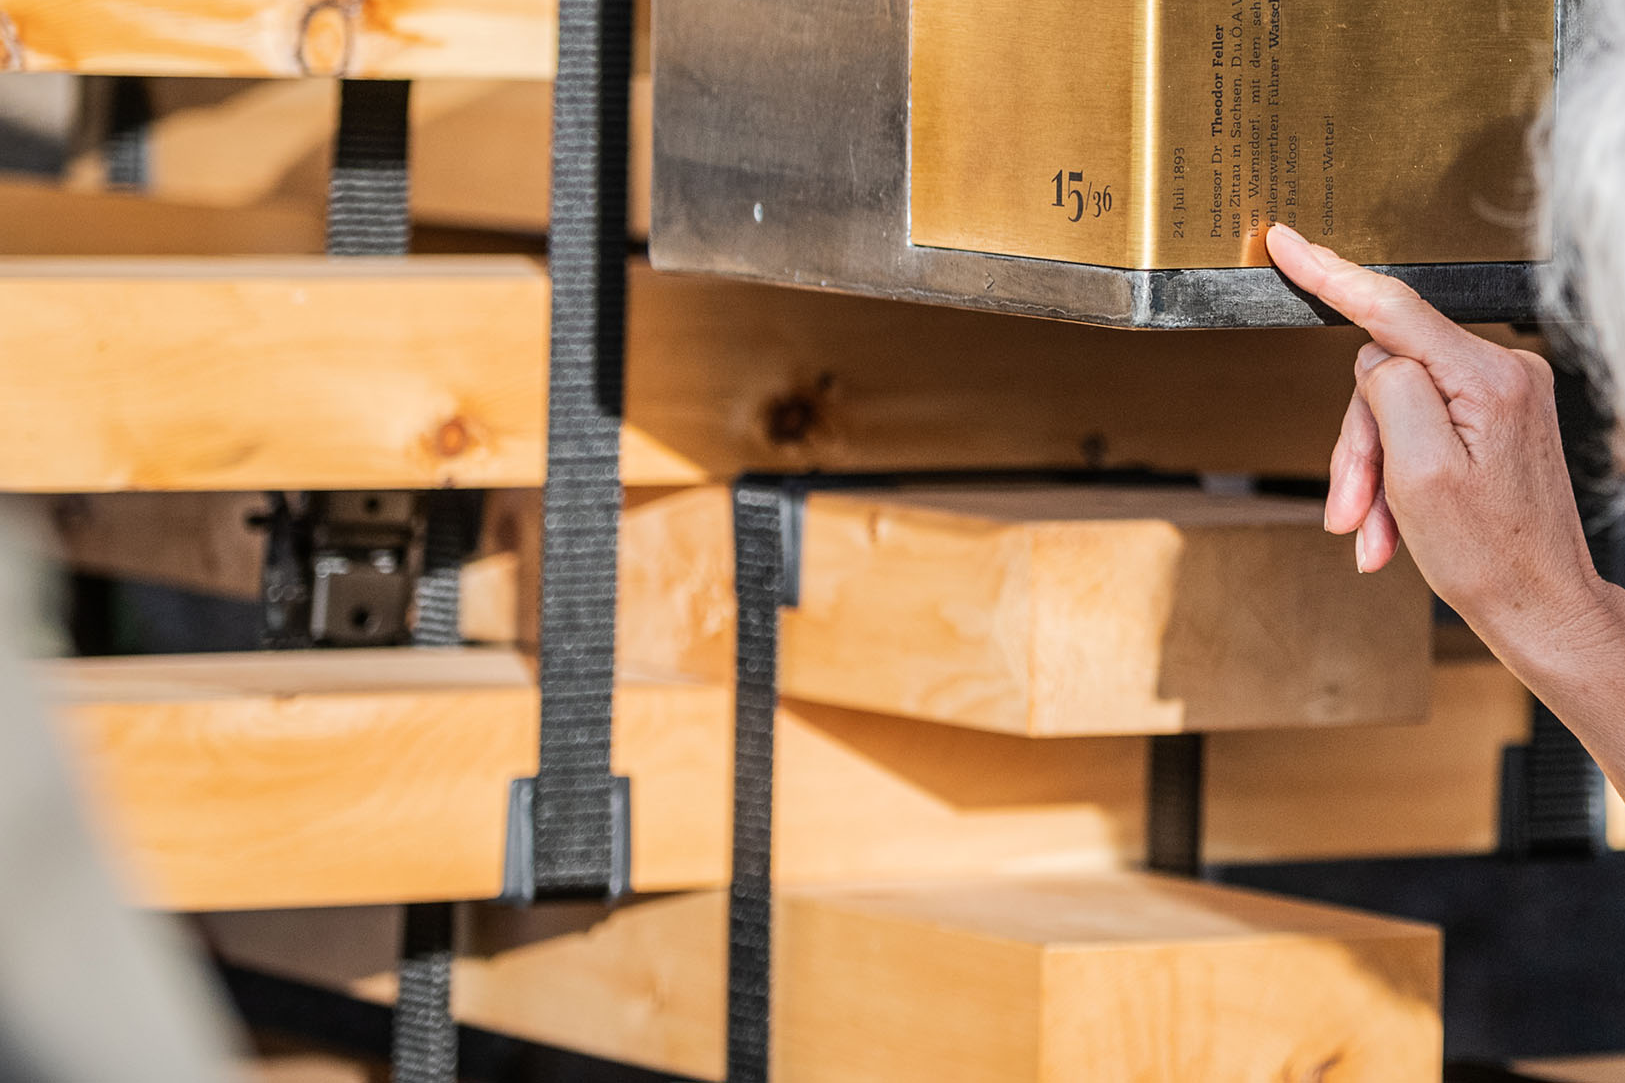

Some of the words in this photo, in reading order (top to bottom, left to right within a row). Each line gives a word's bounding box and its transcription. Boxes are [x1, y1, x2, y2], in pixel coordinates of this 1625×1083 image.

[1212, 24, 1224, 68] Feller
[1249, 36, 1262, 69] dem
[1249, 79, 1261, 104] mit
[1267, 56, 1280, 107] Führer
[1211, 73, 1224, 137] Theodor
[1211, 142, 1223, 165] Dr.
[1230, 144, 1242, 158] in
[1286, 131, 1298, 174] Moos.
[1322, 115, 1335, 171] Wetter!
[1173, 147, 1186, 181] 1893
[1266, 113, 1280, 228] fehlenswerthen
[1051, 169, 1112, 222] 15/36
[1172, 187, 1186, 212] Juli
[1228, 164, 1242, 208] Zittau
[1284, 180, 1297, 207] Bad
[1210, 169, 1223, 238] Professor
[1286, 211, 1297, 229] us
[1322, 175, 1334, 237] Schönes
[1172, 215, 1186, 239] 24.
[1231, 213, 1241, 238] aus
[1248, 209, 1260, 238] tion
